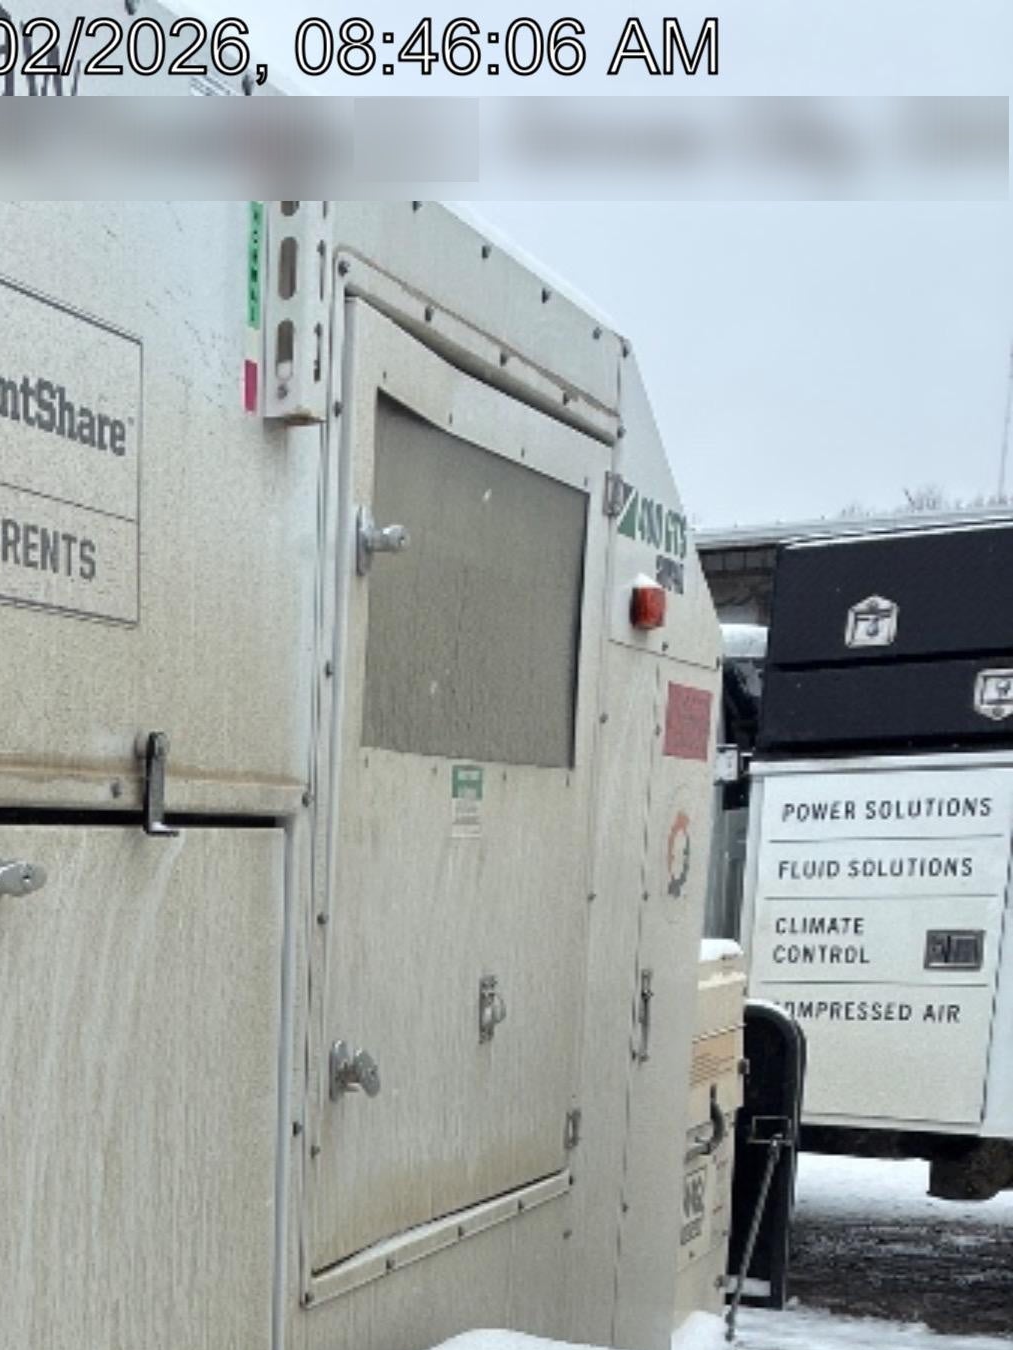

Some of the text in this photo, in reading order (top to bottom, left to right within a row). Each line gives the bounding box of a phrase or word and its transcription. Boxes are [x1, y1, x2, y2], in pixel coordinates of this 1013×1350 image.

[781, 798, 993, 822] POWER SOLUTIONS
[778, 857, 973, 880] FLUID SOLUTIONS
[775, 917, 865, 935] CLIMATE
[772, 945, 870, 965] CONTROL
[774, 1000, 961, 1023] OMPRESSED AIR
